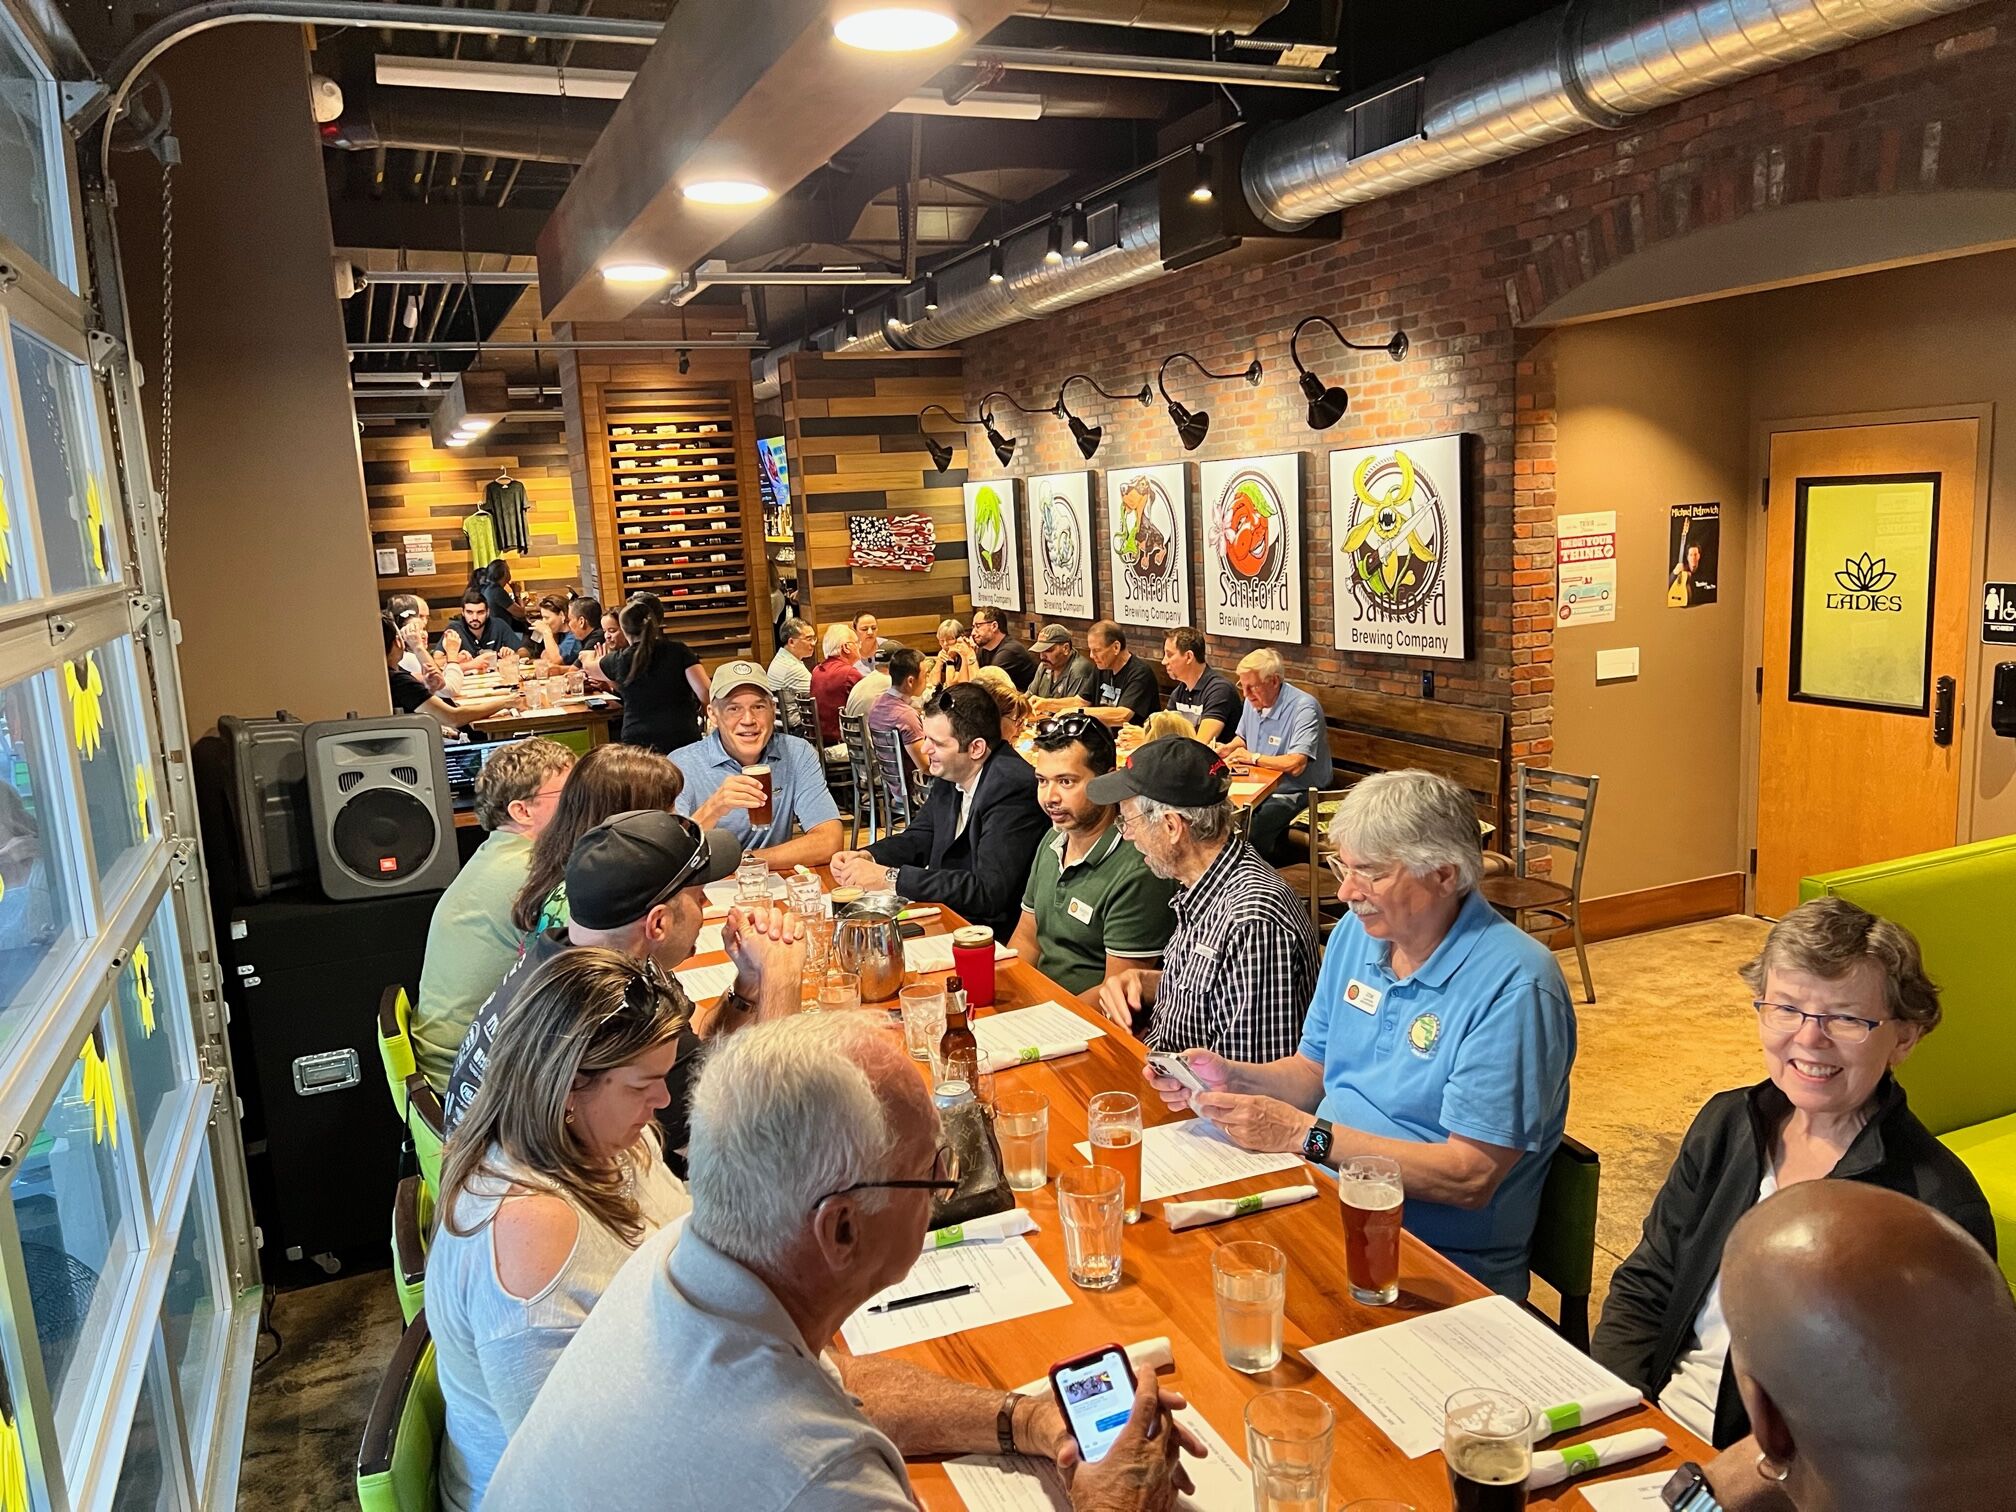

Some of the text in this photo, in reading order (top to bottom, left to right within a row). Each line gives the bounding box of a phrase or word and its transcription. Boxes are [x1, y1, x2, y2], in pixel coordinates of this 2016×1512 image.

[1560, 546, 1604, 562] THINK
[977, 565, 1010, 591] Sanford
[1043, 569, 1083, 597] Sanford
[1124, 569, 1180, 604] Sanford
[1220, 572, 1288, 611] Sanford
[1353, 580, 1446, 625] Sanford
[1826, 593, 1902, 612] LADIES
[1043, 599, 1084, 615] Brewing Company
[1125, 605, 1181, 625] Brewing Company
[1219, 612, 1290, 635] Brewing Company
[1352, 628, 1448, 653] Brewing Company
